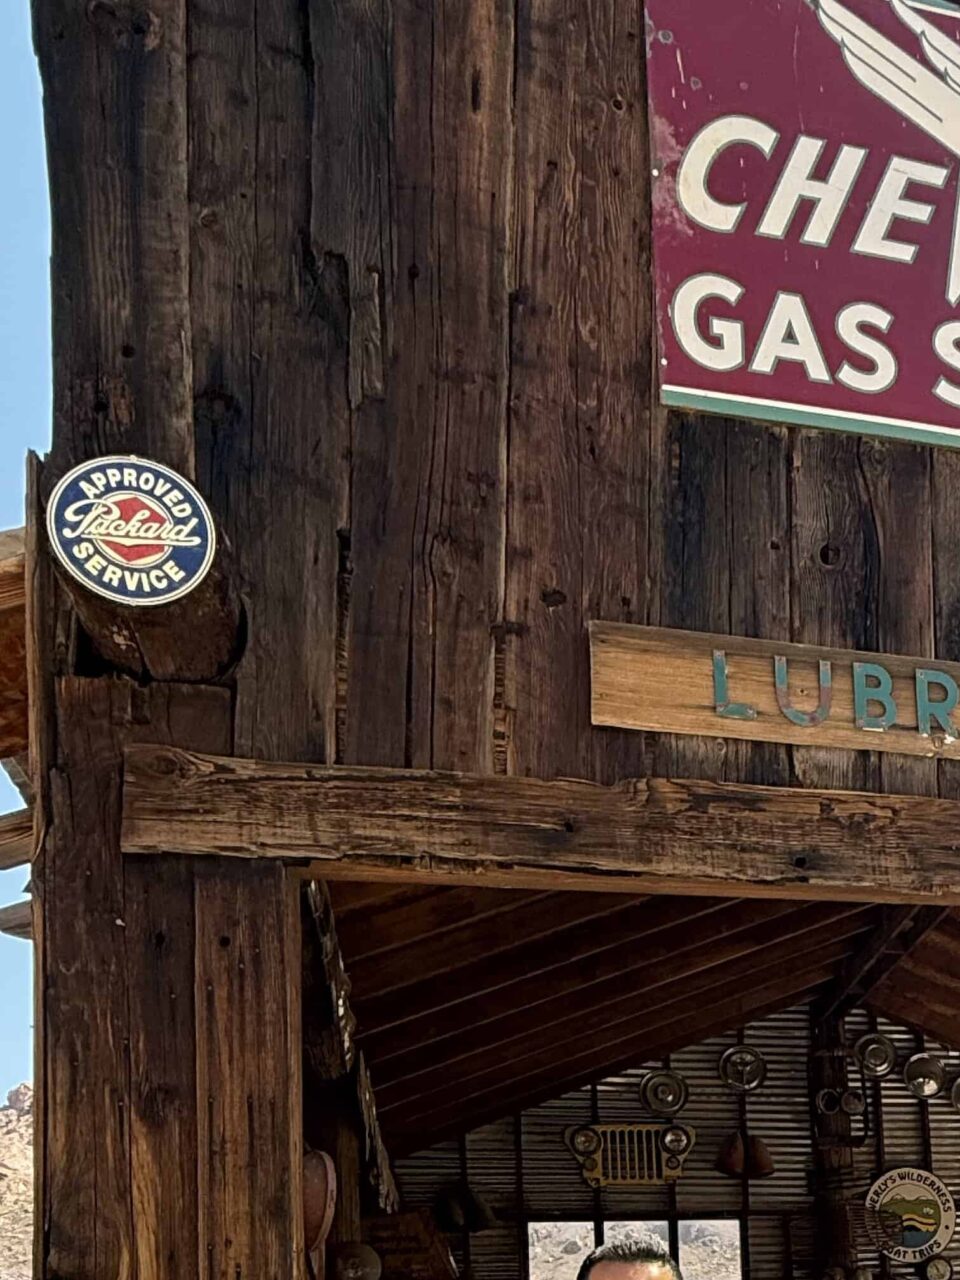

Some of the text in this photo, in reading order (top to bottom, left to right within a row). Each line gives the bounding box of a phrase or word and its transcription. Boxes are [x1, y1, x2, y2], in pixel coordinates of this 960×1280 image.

[670, 272, 898, 394] GAS
[79, 468, 193, 519] APPROVED
[62, 499, 202, 546] Packard
[72, 542, 186, 592] SERVICE
[897, 1171, 952, 1213] WILDERNESS
[912, 1239, 941, 1259] TRIPS
